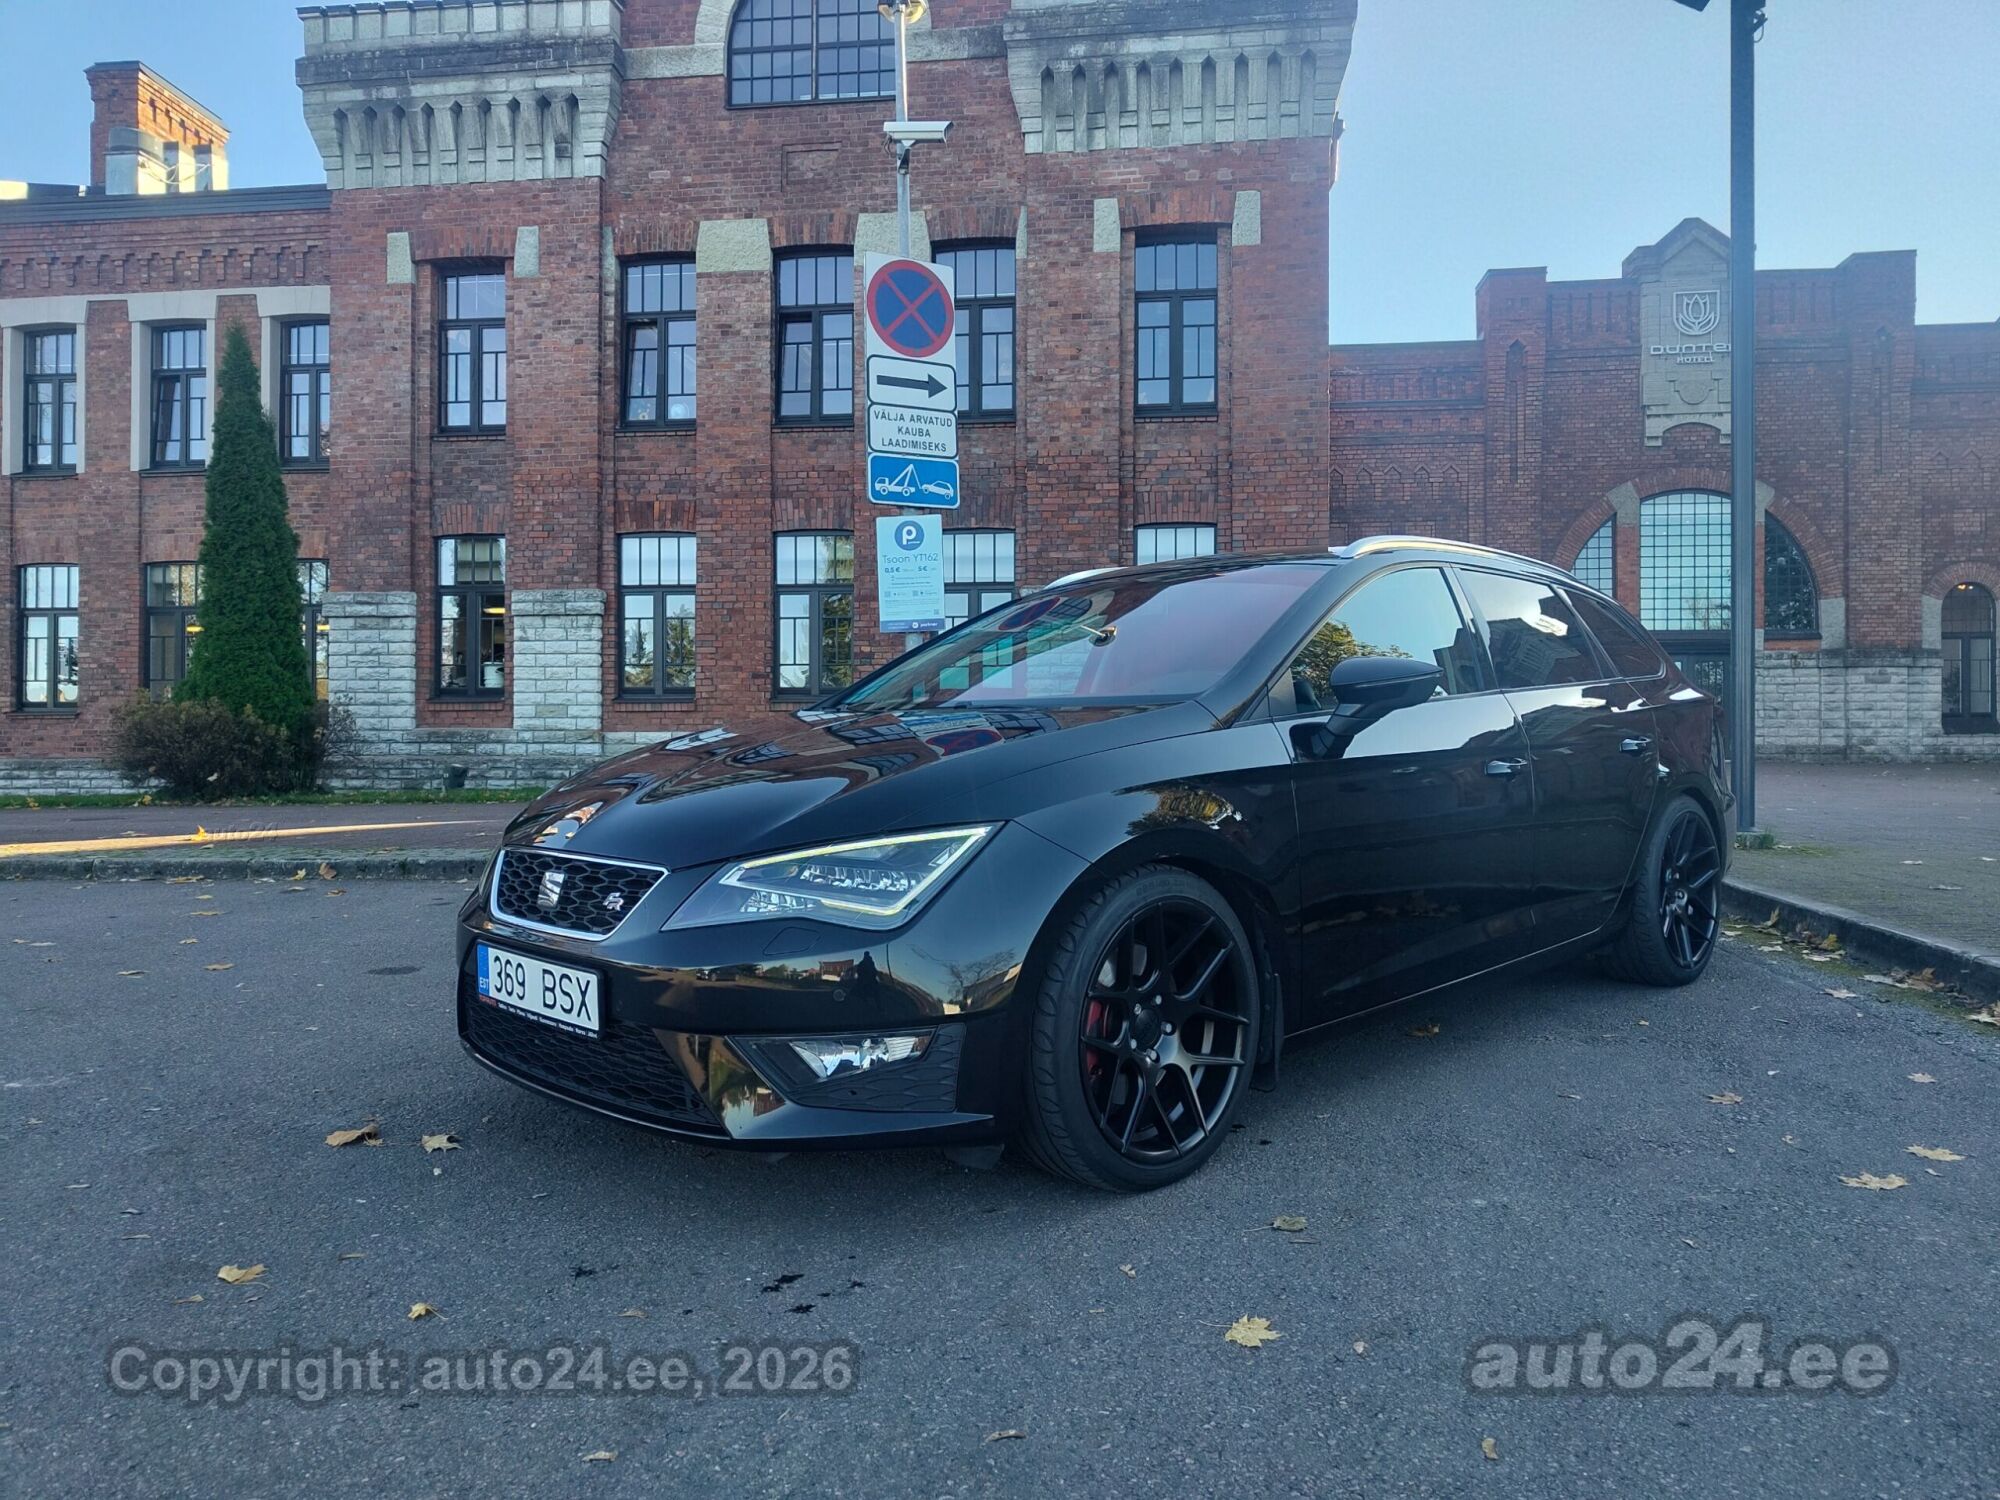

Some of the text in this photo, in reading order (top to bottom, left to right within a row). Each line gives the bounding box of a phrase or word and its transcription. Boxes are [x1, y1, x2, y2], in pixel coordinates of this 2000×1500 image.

[873, 409, 953, 427] VÄLJA ARVATUD
[897, 425, 931, 438] KAUBA
[881, 437, 947, 452] LAADIMISEKS
[882, 554, 911, 564] Tsoon
[479, 976, 489, 989] EST
[493, 955, 526, 1001] 369
[542, 968, 592, 1022] BSX
